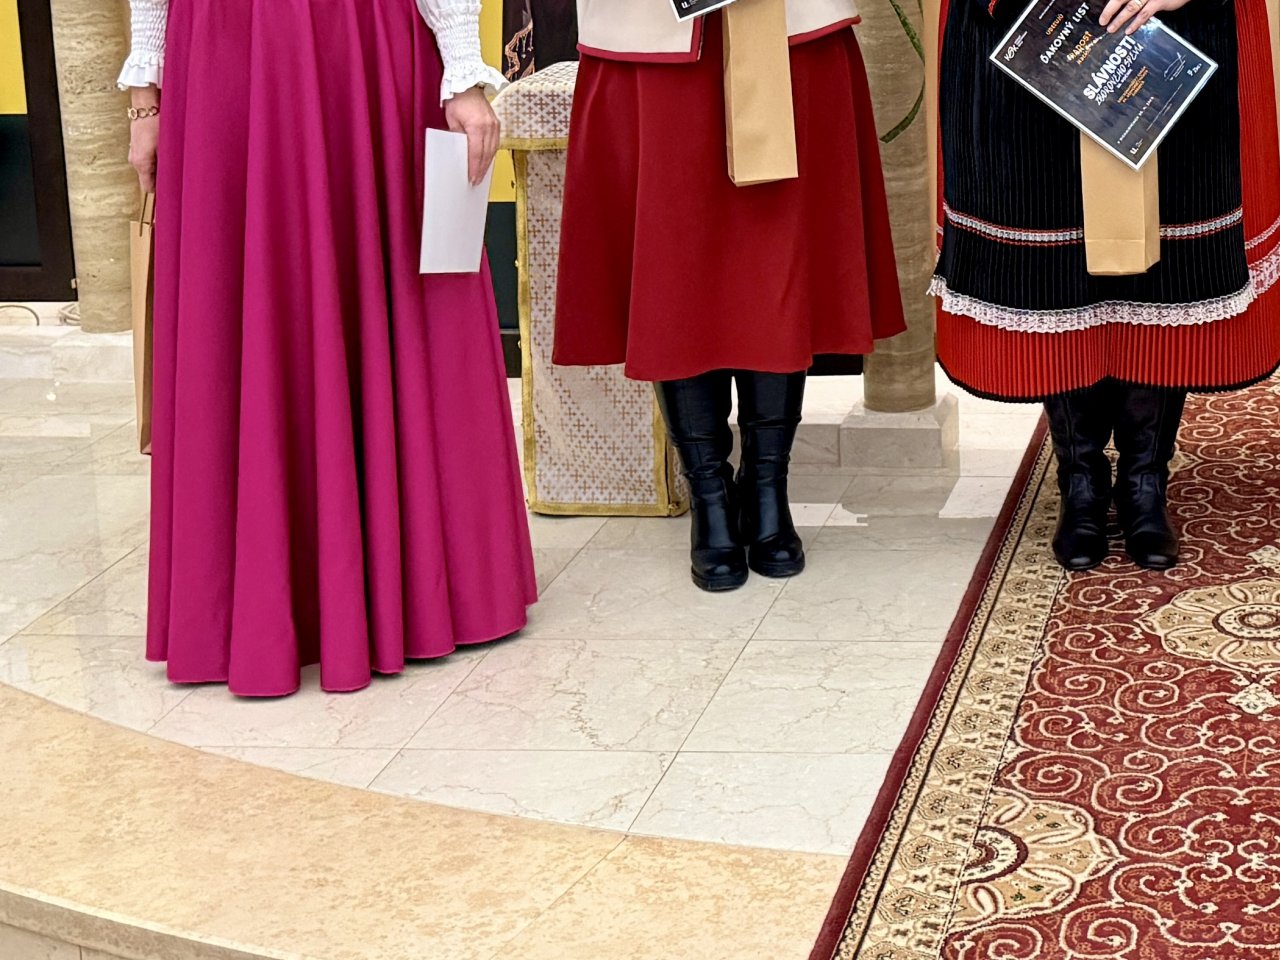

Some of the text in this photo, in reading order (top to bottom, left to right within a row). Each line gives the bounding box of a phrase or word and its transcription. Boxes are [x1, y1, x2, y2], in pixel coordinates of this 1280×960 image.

[1039, 21, 1074, 64] ĎAKOVNÝ
[1072, 2, 1090, 23] LIST
[1083, 35, 1136, 100] SLÁVNOSTI
